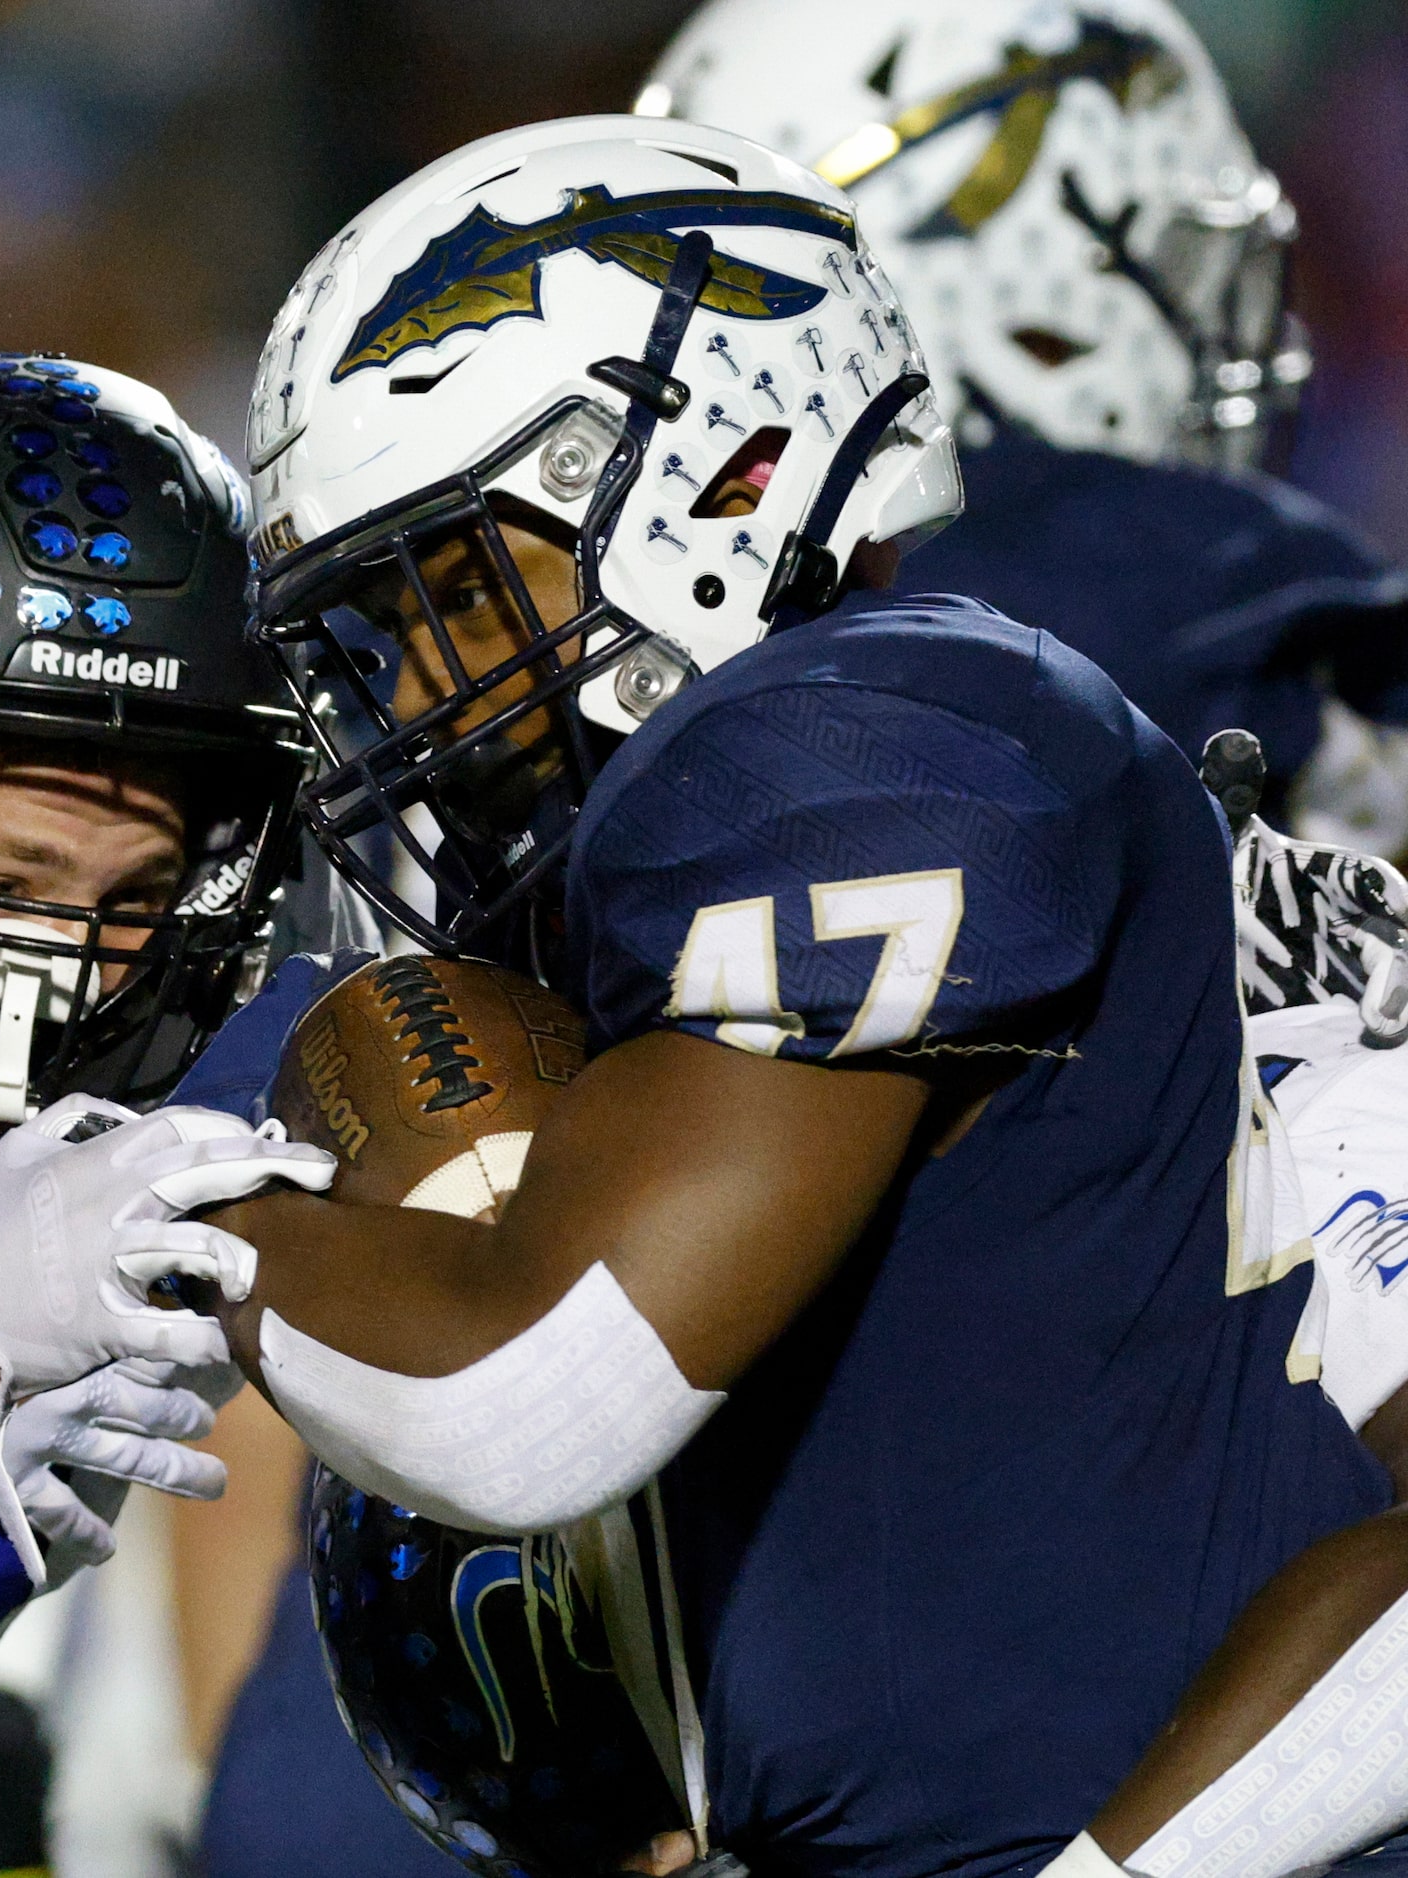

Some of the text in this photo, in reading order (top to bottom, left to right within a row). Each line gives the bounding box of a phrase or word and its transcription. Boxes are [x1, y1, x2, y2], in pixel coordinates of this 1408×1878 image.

[31, 640, 179, 690] Riddell
[663, 868, 965, 1058] 47
[299, 1015, 370, 1161] Wilson
[1200, 1768, 1270, 1831] BATTLE
